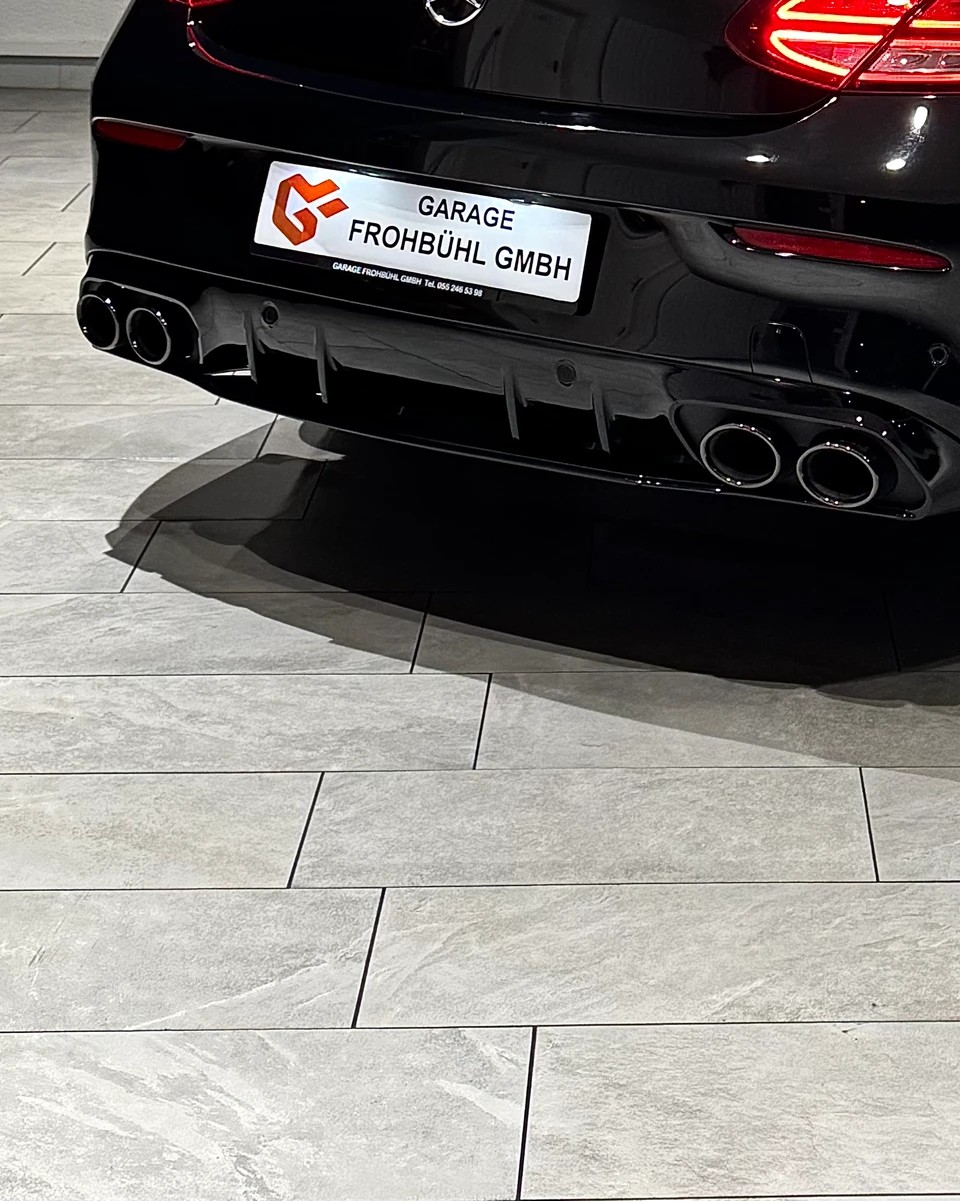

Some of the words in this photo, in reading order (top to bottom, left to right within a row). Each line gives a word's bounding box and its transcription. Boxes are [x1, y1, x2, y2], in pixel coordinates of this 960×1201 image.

[418, 195, 515, 231] GARAGE
[348, 219, 486, 266] FROHBÜHL
[495, 245, 572, 281] GMBH
[332, 261, 362, 275] GARAGE
[361, 267, 400, 282] FROHBÜHL
[400, 274, 423, 286] GMBH
[424, 278, 436, 289] Tel.
[436, 281, 450, 291] 055
[450, 284, 464, 294] 246
[463, 286, 474, 296] 53
